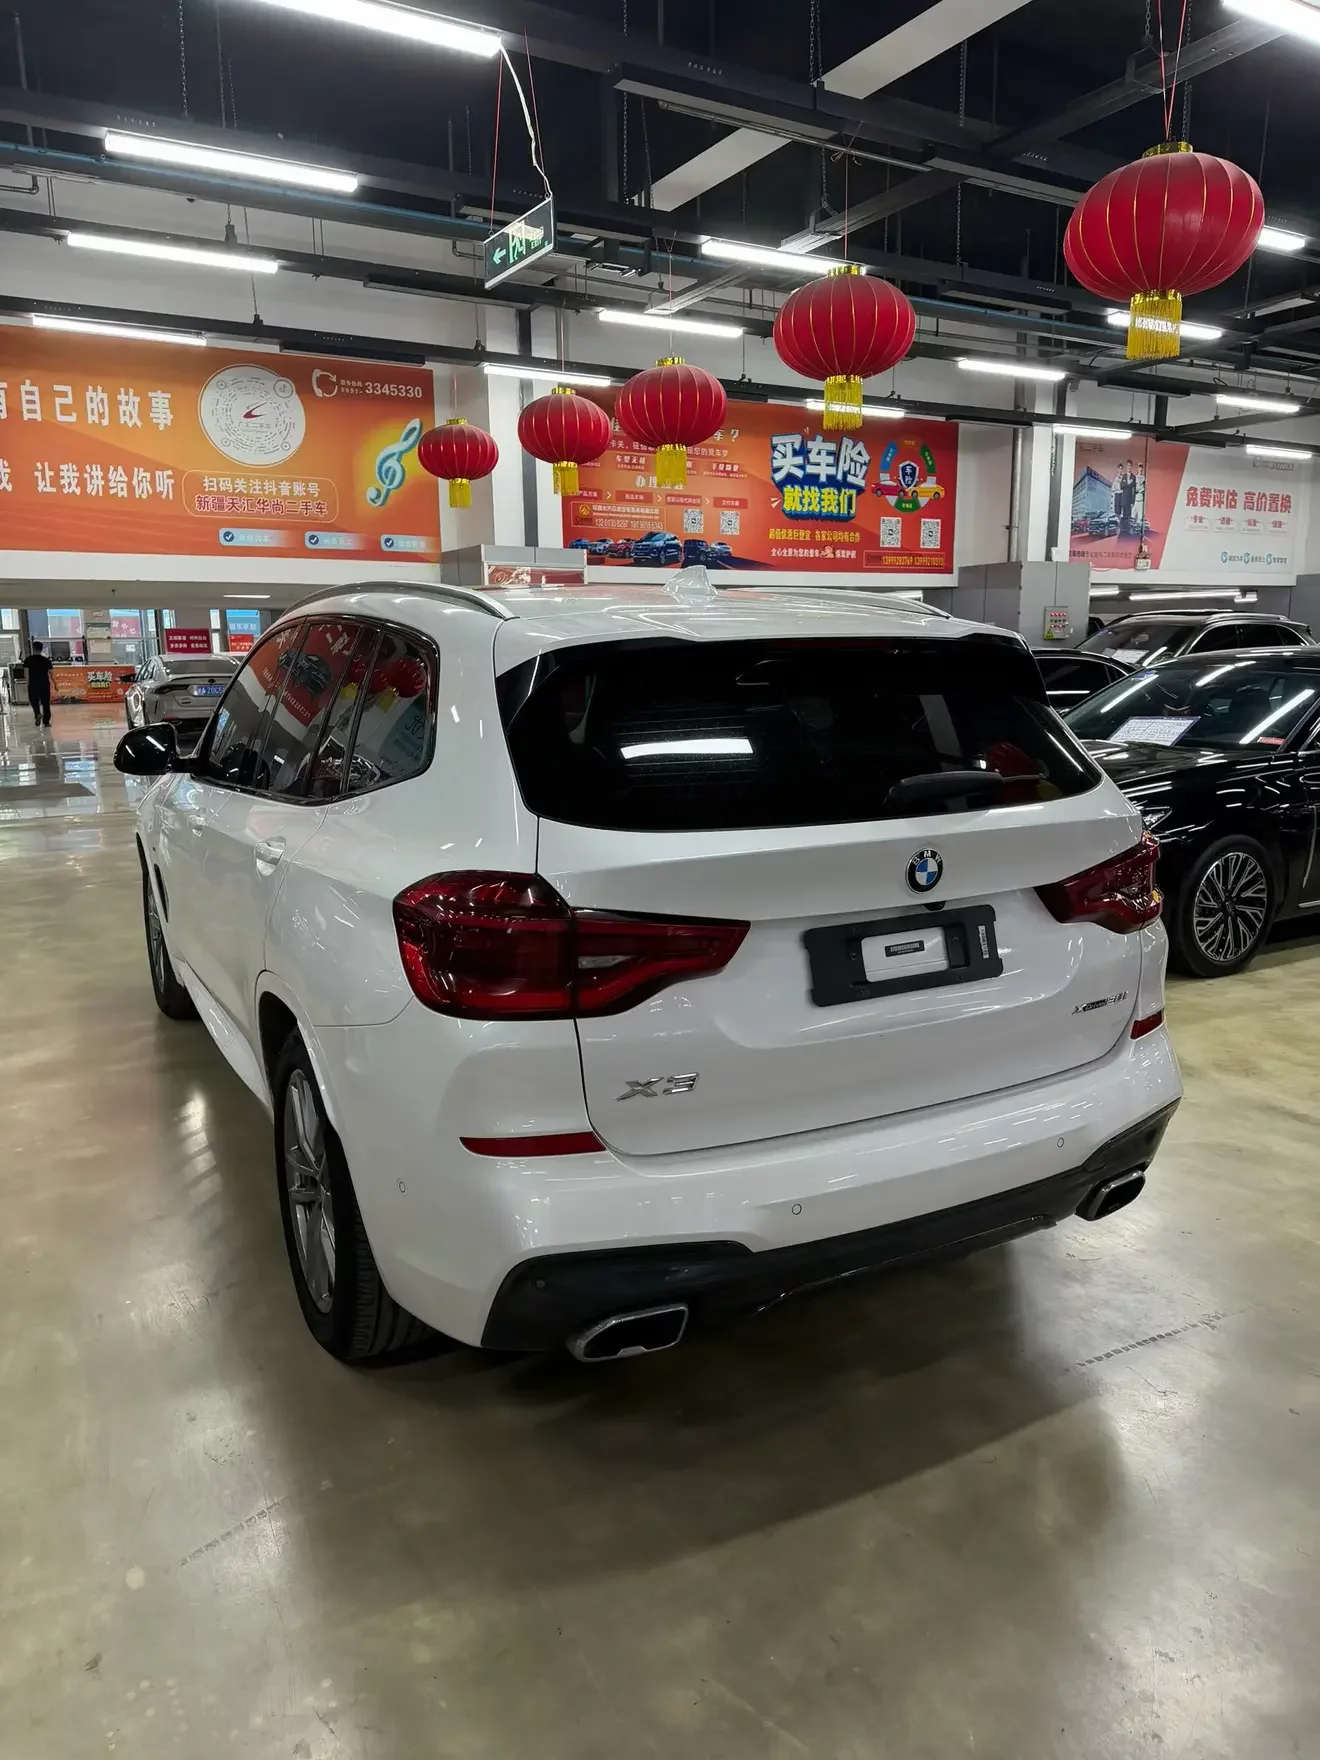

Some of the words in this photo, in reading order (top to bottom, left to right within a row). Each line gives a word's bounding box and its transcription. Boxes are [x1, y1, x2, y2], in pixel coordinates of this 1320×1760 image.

[365, 381, 422, 399] 3345330
[771, 433, 871, 487] 买车险
[34, 461, 174, 500] 让我讲给你听
[203, 476, 320, 498] 扫码关注抖音账号
[196, 494, 328, 517] 新疆天汇华尚二手车
[783, 484, 857, 516] 就找我们
[1186, 486, 1239, 510] 免费评估
[1243, 491, 1293, 514] 高价置换
[614, 1071, 700, 1101] X3
